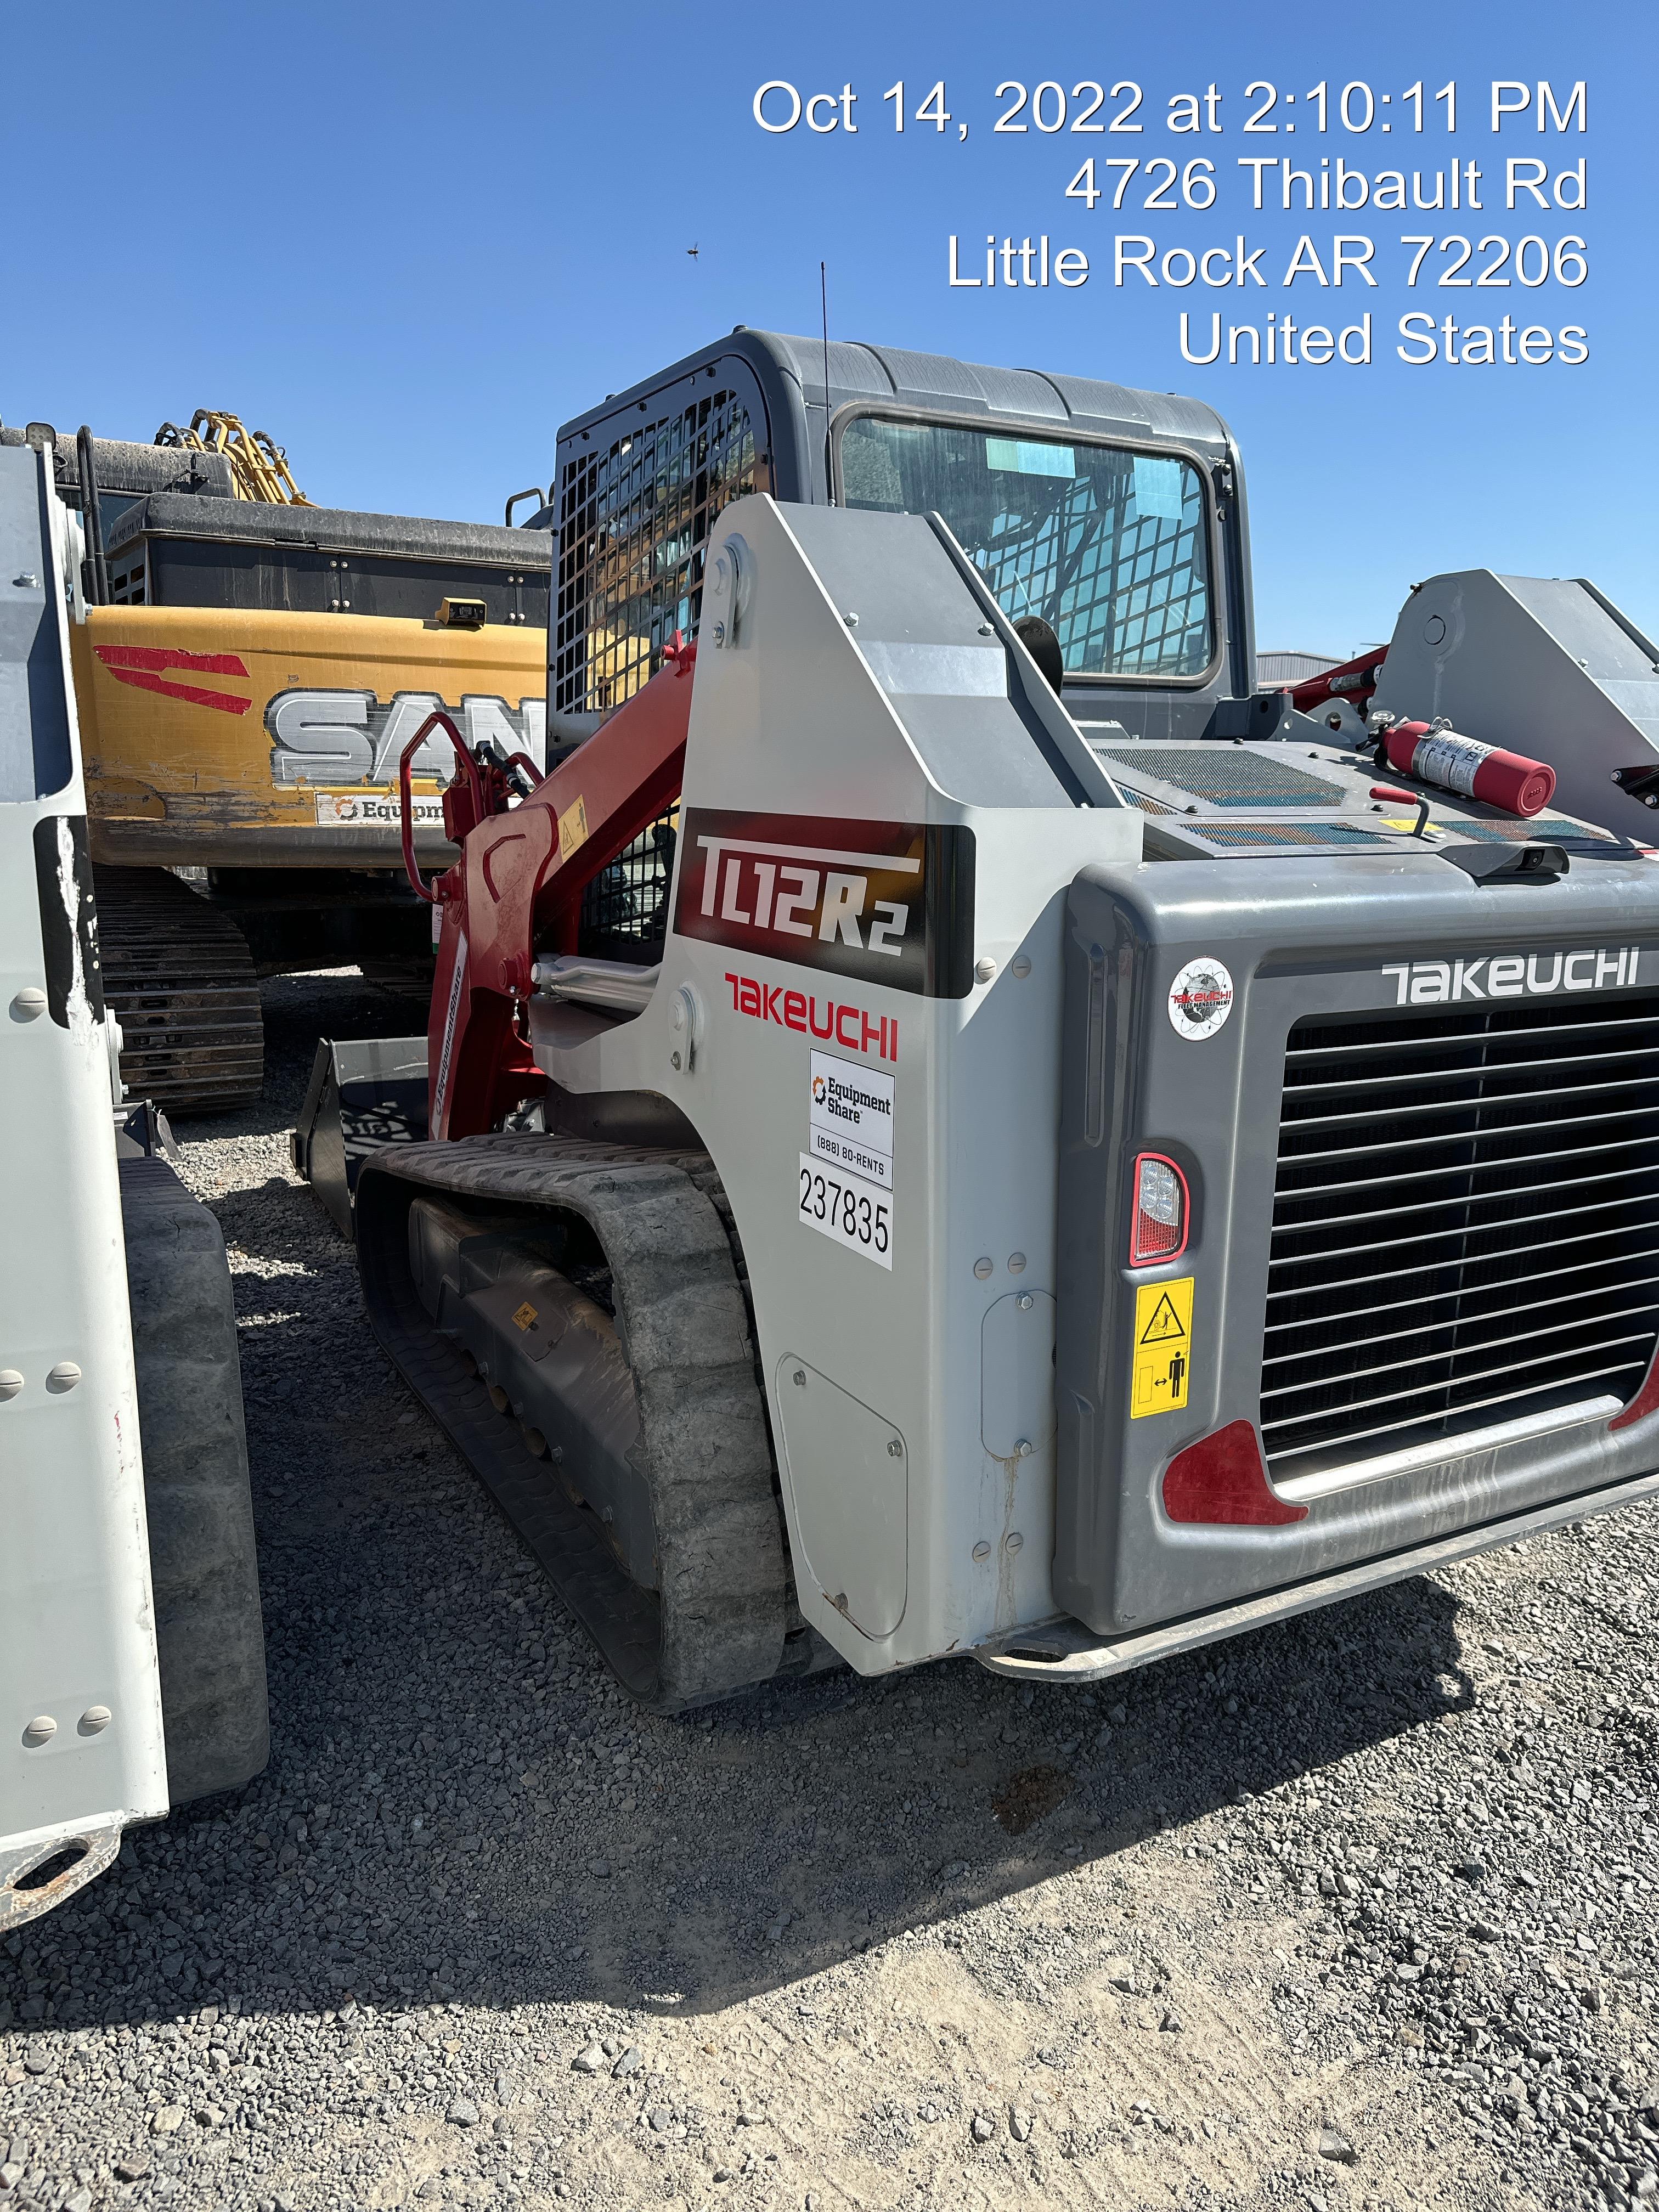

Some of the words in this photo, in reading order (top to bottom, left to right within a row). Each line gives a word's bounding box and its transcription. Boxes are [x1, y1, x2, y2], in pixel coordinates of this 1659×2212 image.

[1193, 1000, 1231, 1008] MANAGEMENT
[828, 1076, 891, 1116] Equipment
[817, 1135, 840, 1156] (888)
[842, 1146, 885, 1176] 80-RENTS
[800, 1167, 889, 1254] 237835
